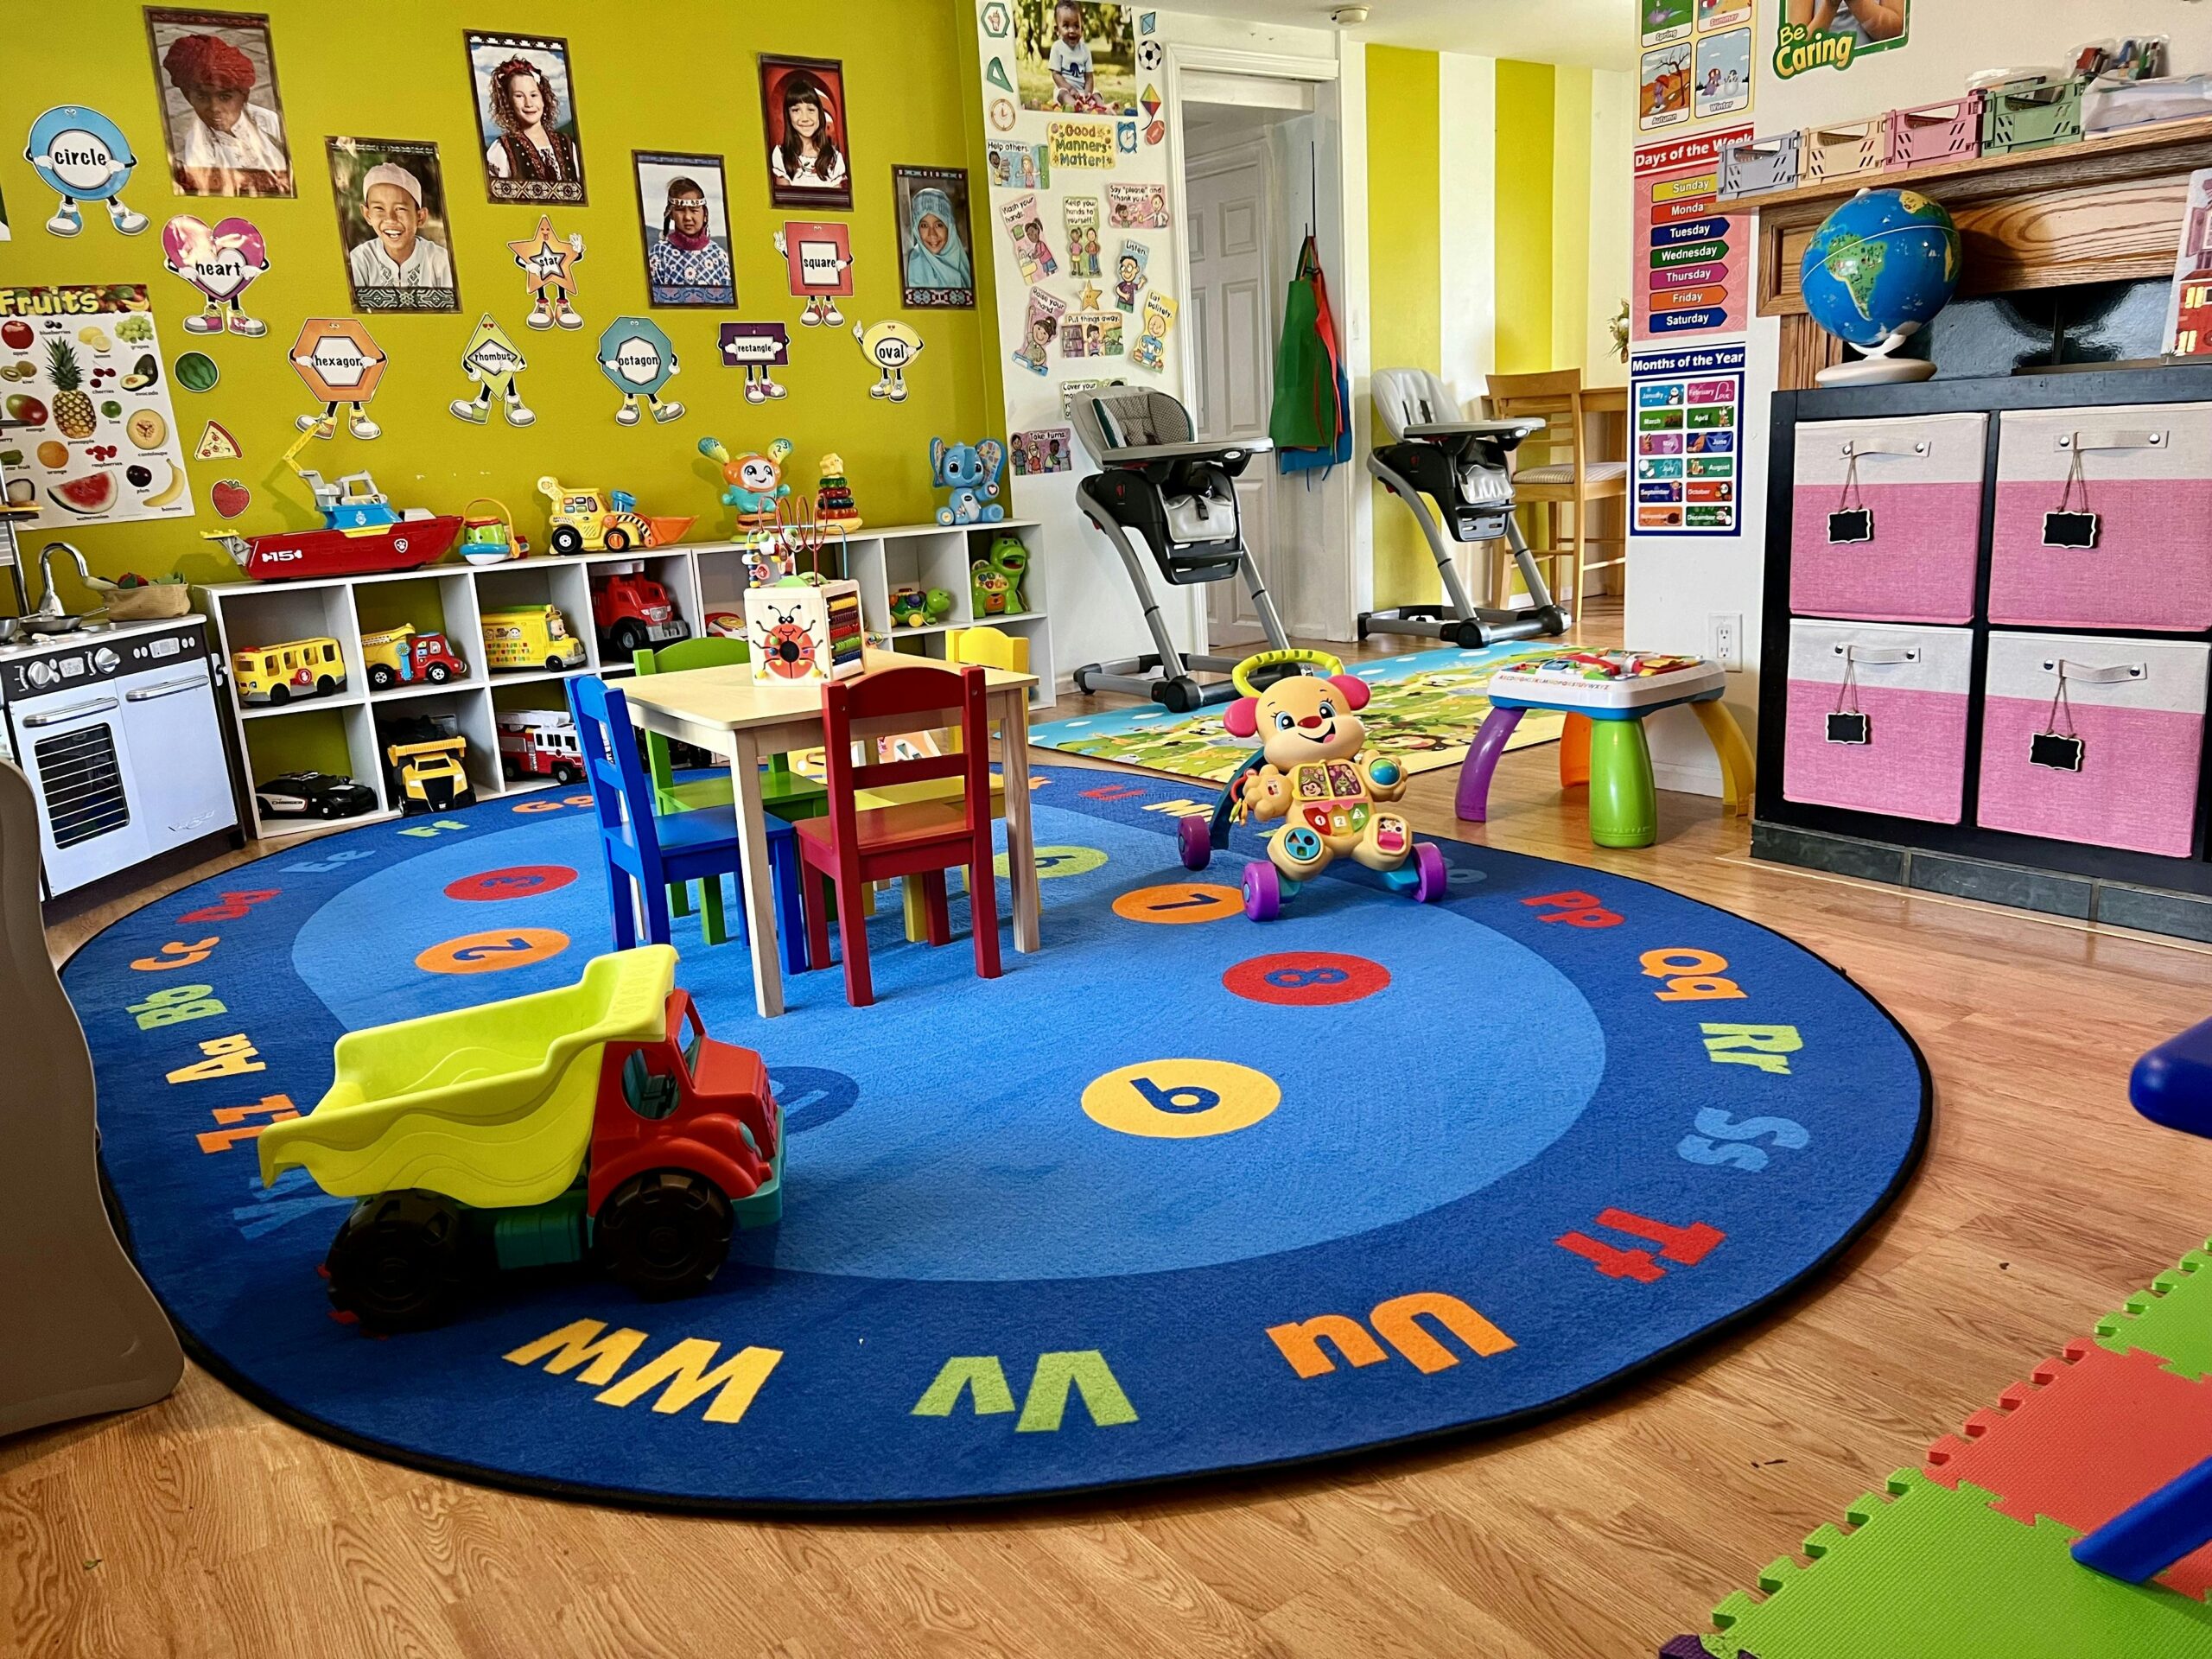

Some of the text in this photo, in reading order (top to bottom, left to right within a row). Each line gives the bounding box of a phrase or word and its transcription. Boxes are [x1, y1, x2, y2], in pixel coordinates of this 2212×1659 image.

[1709, 13, 1738, 27] Summer
[1656, 29, 1677, 41] Spring
[1780, 24, 1806, 46] Be
[1777, 33, 1853, 77] Caring
[1709, 100, 1733, 112] Winter
[1652, 113, 1677, 124] Autumn
[1065, 124, 1096, 137] Good
[988, 142, 1030, 152] Help others.
[1055, 138, 1107, 153] Manners
[54, 147, 107, 168] circle
[1059, 154, 1105, 168] Matter!
[1635, 152, 1667, 168] Days
[1669, 147, 1685, 162] of
[1687, 144, 1709, 157] the
[1109, 185, 1122, 194] Say
[1673, 180, 1709, 194] Sunday
[1002, 197, 1034, 214] Wash your
[1065, 199, 1080, 207] Keep
[1671, 203, 1706, 216] Monda
[1669, 224, 1711, 238] Tuesday
[1126, 240, 1147, 256] Listen.
[1661, 245, 1718, 262] Wednesday
[195, 259, 240, 276] heart
[539, 256, 559, 268] star
[802, 256, 836, 270] square
[1666, 270, 1712, 283] Thursday
[0, 287, 99, 316] Fruits
[1033, 289, 1065, 309] Raise your
[1149, 292, 1161, 302] Eat
[1673, 290, 1703, 304] Friday
[1666, 313, 1709, 326] Saturday
[738, 344, 772, 354] rectangle
[878, 344, 906, 359] oval
[315, 354, 363, 369] hexagon
[474, 351, 512, 363] rhombus
[617, 354, 658, 368] octagon
[1632, 353, 1744, 372] Months of the Year
[1688, 389, 1715, 397] February
[130, 937, 221, 971] Cc
[453, 937, 533, 961] 2
[1263, 968, 1350, 988] 8
[125, 984, 228, 1031] Bb
[1699, 1023, 1804, 1075] Rr
[166, 1033, 266, 1084] Aa
[1676, 1106, 1810, 1173] Ss
[1265, 1291, 1517, 1377] Uu
[501, 1318, 785, 1424] Ww
[909, 1349, 1140, 1433] Vv
